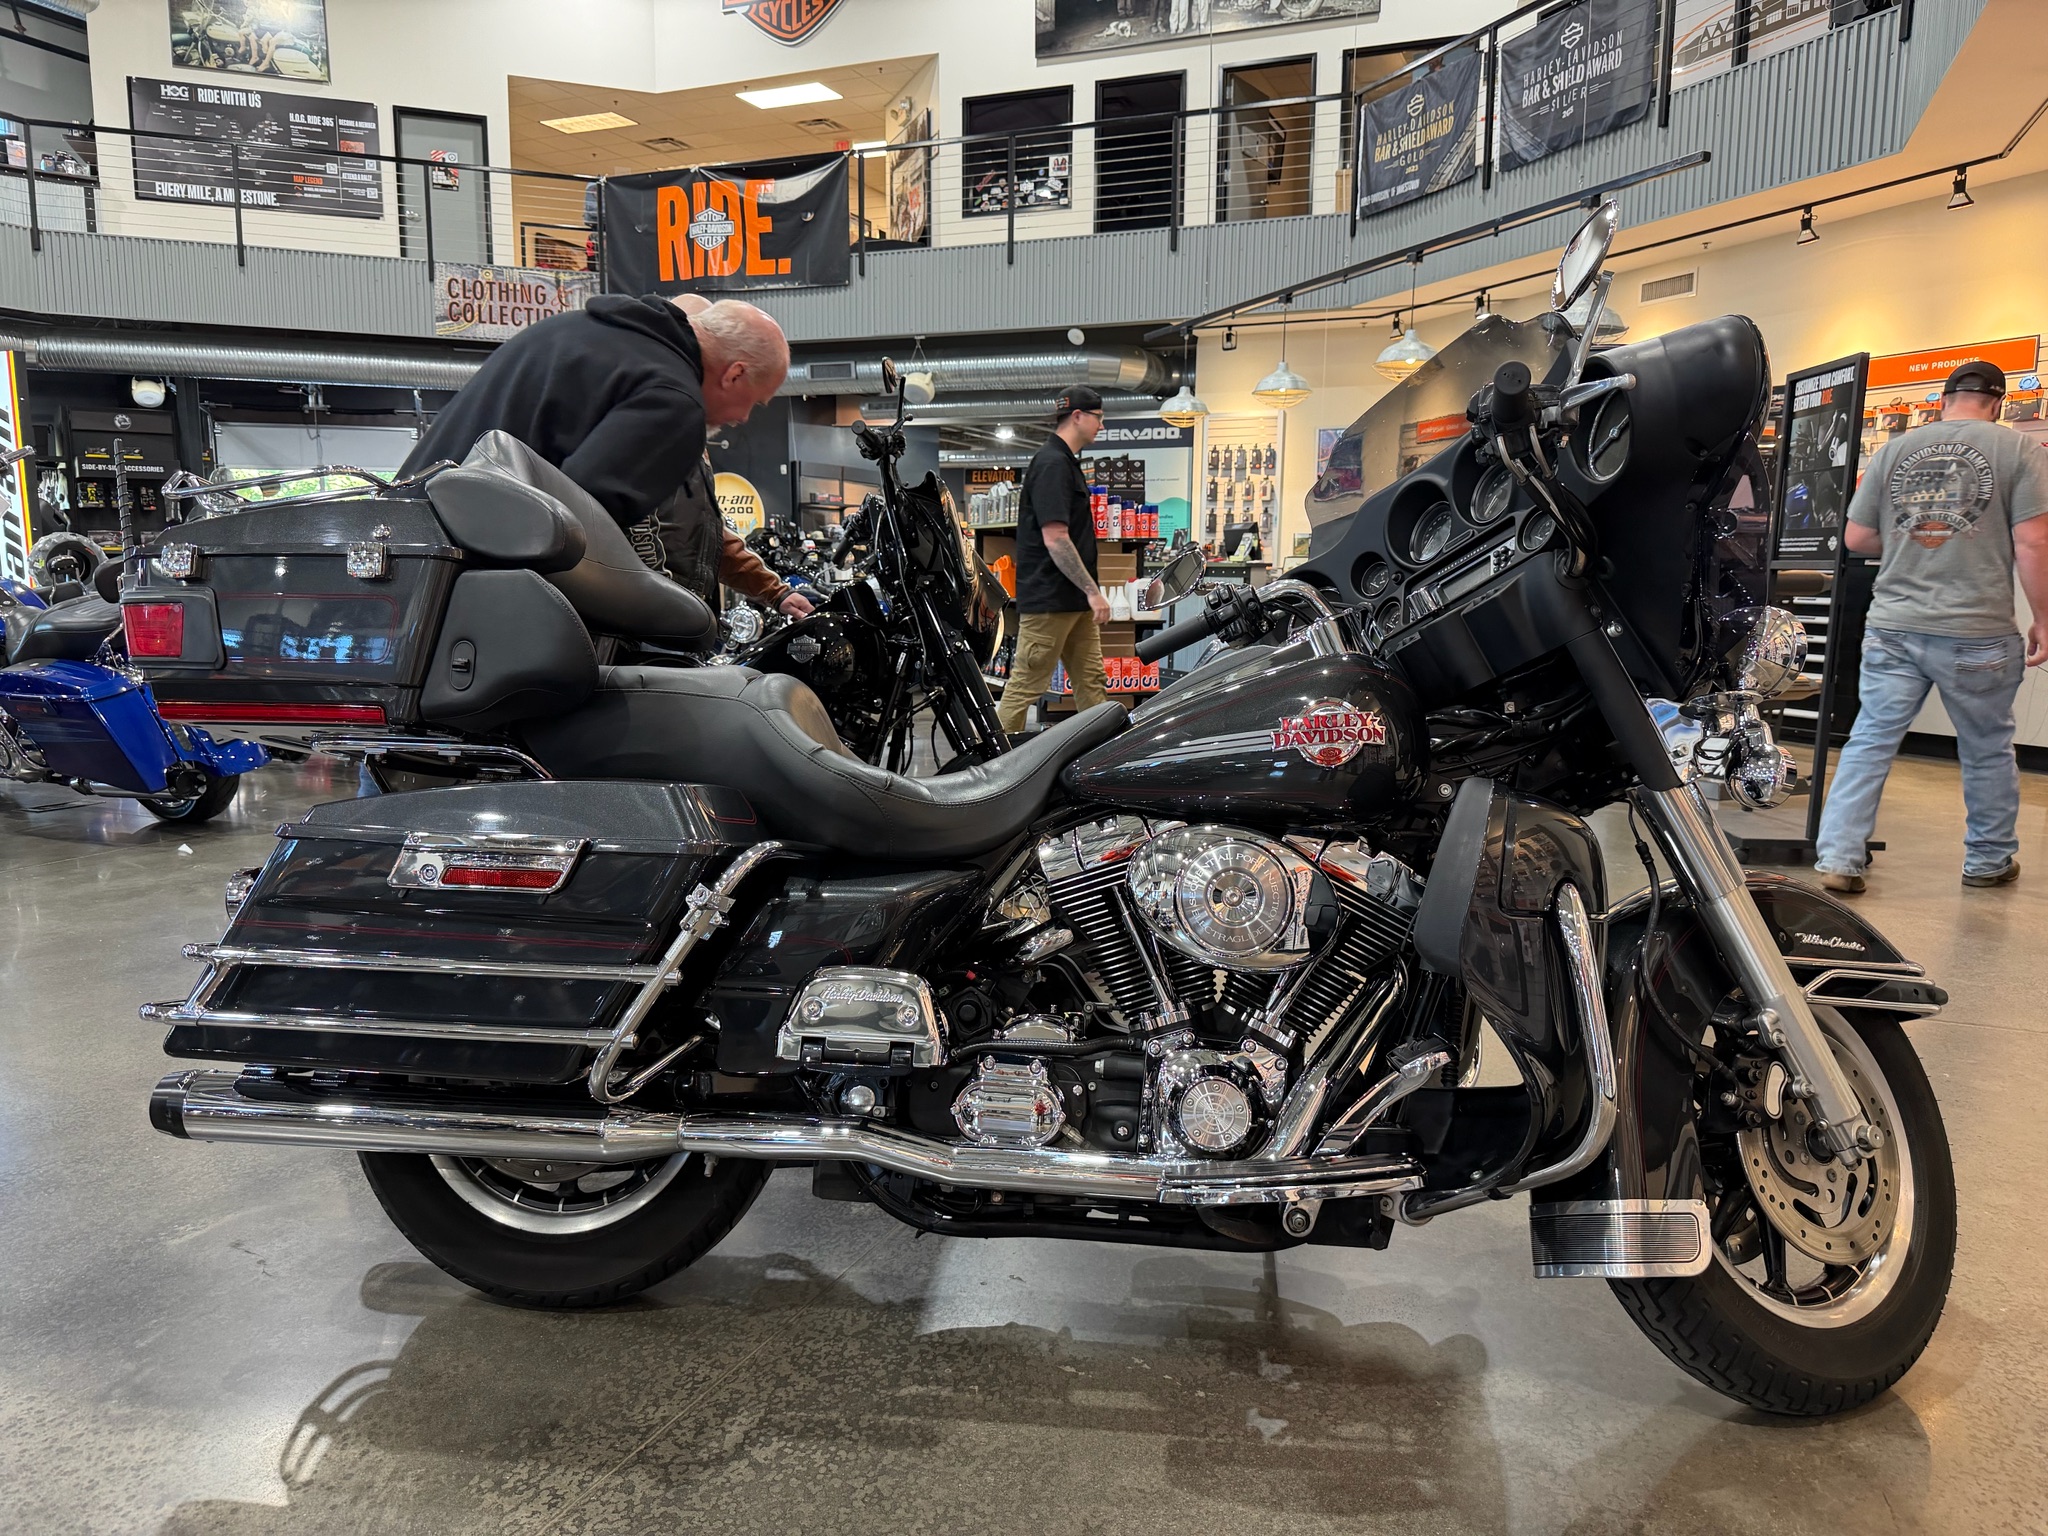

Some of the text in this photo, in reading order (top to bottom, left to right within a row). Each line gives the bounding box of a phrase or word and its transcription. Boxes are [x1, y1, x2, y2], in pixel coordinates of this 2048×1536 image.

[759, 0, 824, 31] CYCLES
[1522, 48, 1622, 108] BAR & SHIELD AWARD
[160, 84, 262, 108] HOG RIDE WITH US
[307, 115, 320, 125] RIDE
[321, 117, 335, 127] 365
[1375, 115, 1454, 163] BAR & SHIELD AWARD
[1400, 150, 1424, 166] GOLD
[155, 181, 280, 206] EVERY MILE, A MIESTONE.
[657, 178, 791, 281] RIDE.
[447, 278, 573, 308] CLOTHING &
[448, 301, 561, 327] COLLECTI
[1909, 357, 1980, 372] NEW PRODU
[972, 470, 1015, 482] ELEVATOR
[1953, 444, 1968, 455] OF
[1963, 449, 1994, 501] JAMESTOWN
[717, 495, 754, 505] n-am
[1281, 712, 1380, 731] HARLEY-
[1273, 728, 1385, 749] DAVIDSON
[1190, 853, 1280, 926] SEQUENTAL POR INJECTION
[1795, 932, 1830, 946] Ultra
